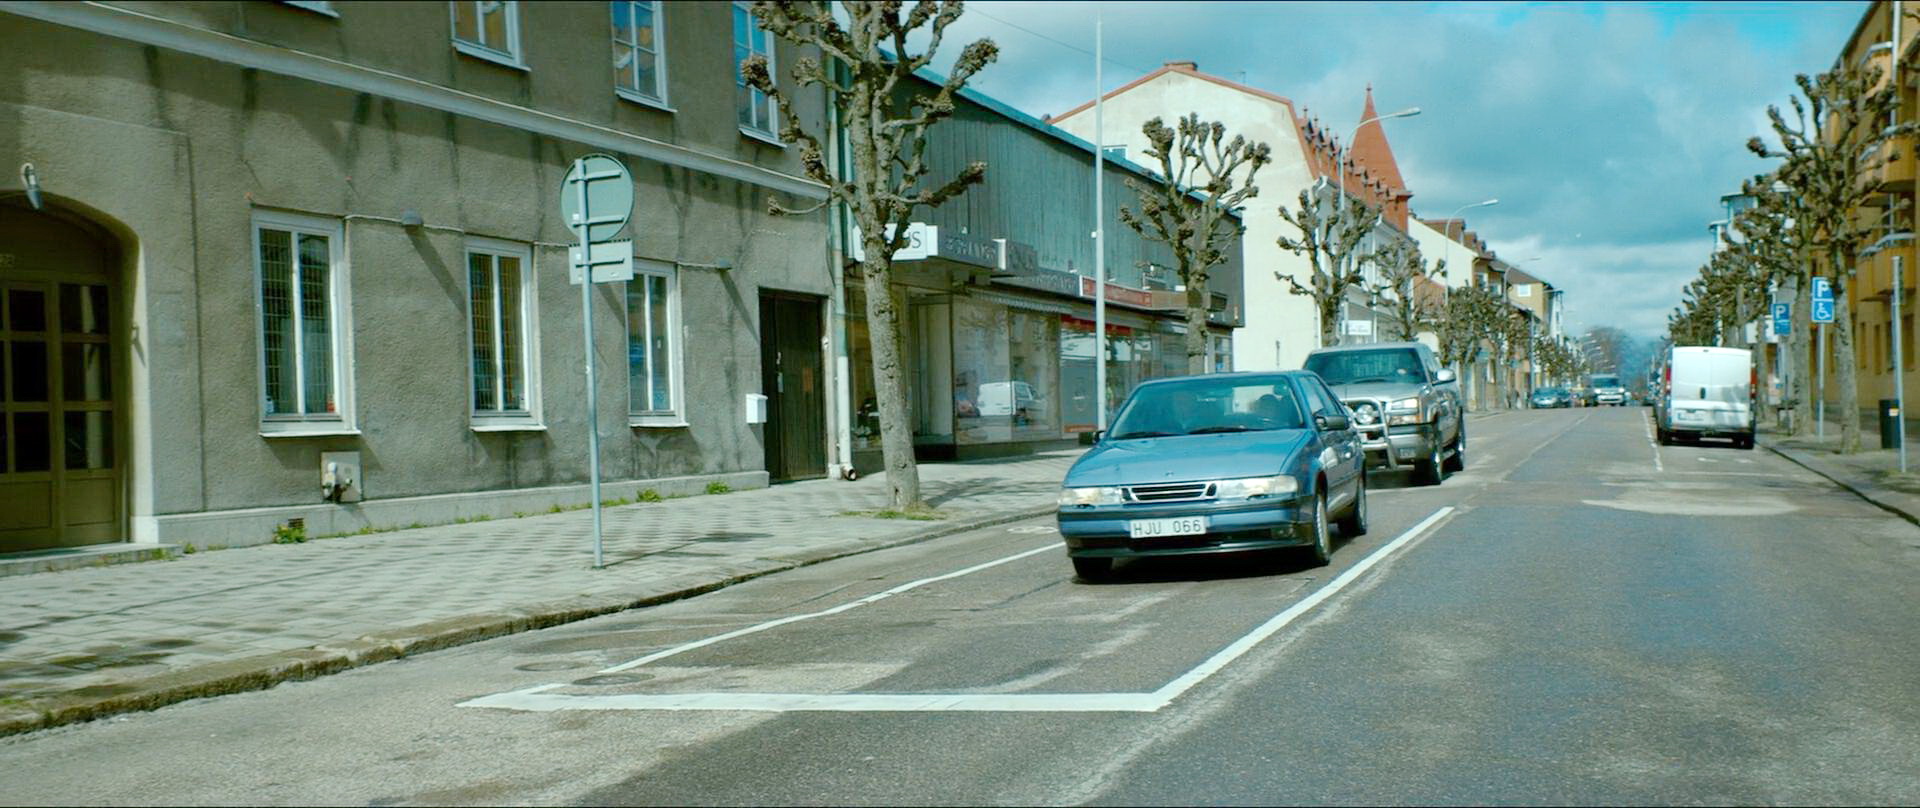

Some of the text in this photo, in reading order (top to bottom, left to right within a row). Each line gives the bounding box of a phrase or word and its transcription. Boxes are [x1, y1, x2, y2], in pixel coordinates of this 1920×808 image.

[1817, 280, 1830, 297] P
[1775, 305, 1786, 320] P
[1133, 519, 1201, 536] HJU 066
